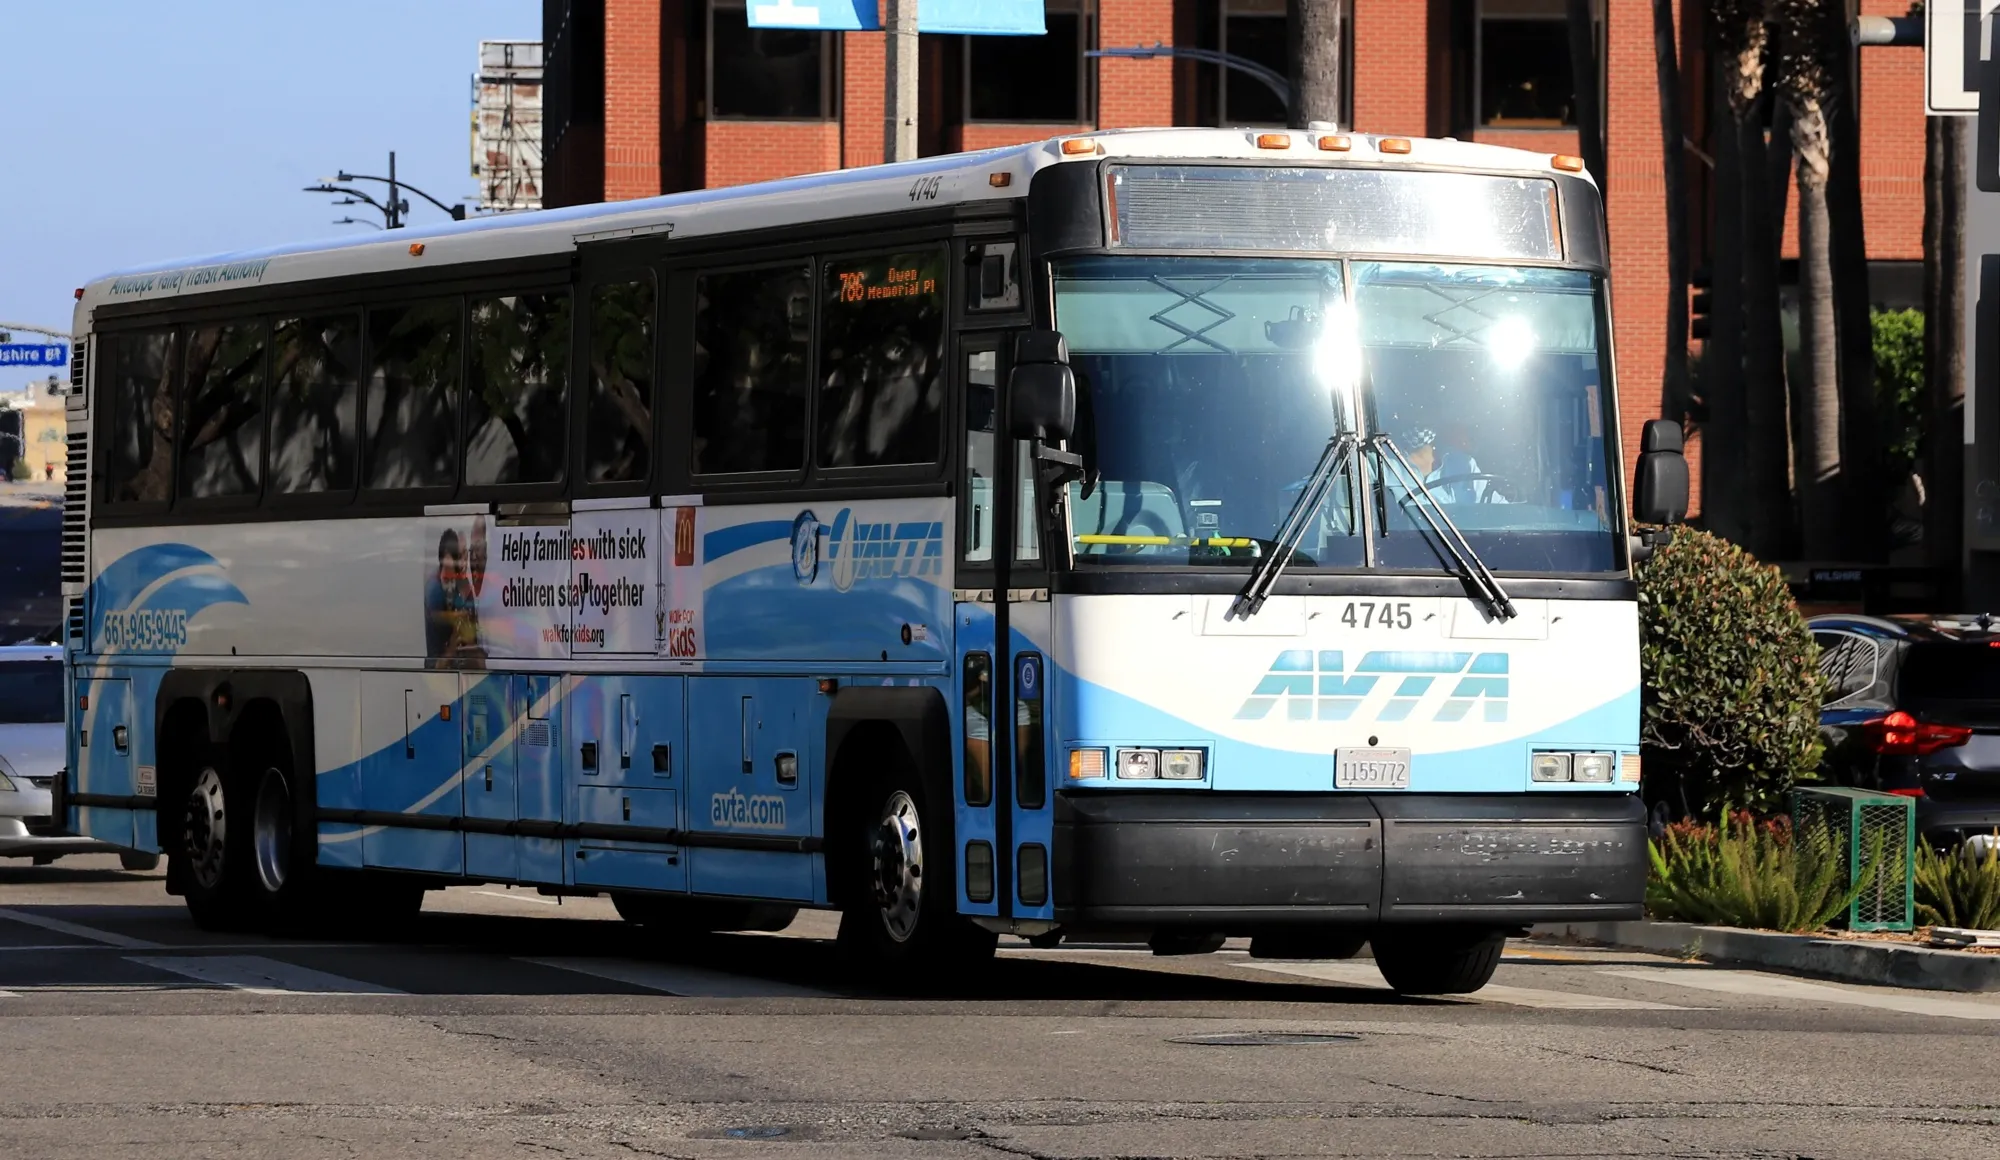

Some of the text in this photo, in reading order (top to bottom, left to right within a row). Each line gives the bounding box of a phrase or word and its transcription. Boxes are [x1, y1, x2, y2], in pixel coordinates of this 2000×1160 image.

[909, 176, 943, 201] 4745
[109, 259, 271, 297] Antelope Valley Transit Authority
[840, 271, 865, 302] 786
[867, 281, 919, 300] Memorial
[888, 267, 917, 283] Owen
[501, 527, 646, 569] Help families with sick
[853, 521, 944, 580] AVTA
[502, 576, 644, 615] children stay together
[104, 613, 187, 646] 661-945-9445
[1341, 602, 1412, 630] 4745
[542, 623, 605, 648] walkforkids.org
[1232, 650, 1509, 722] AVTA
[1341, 762, 1406, 782] 1155772
[712, 792, 784, 825] avta.com
